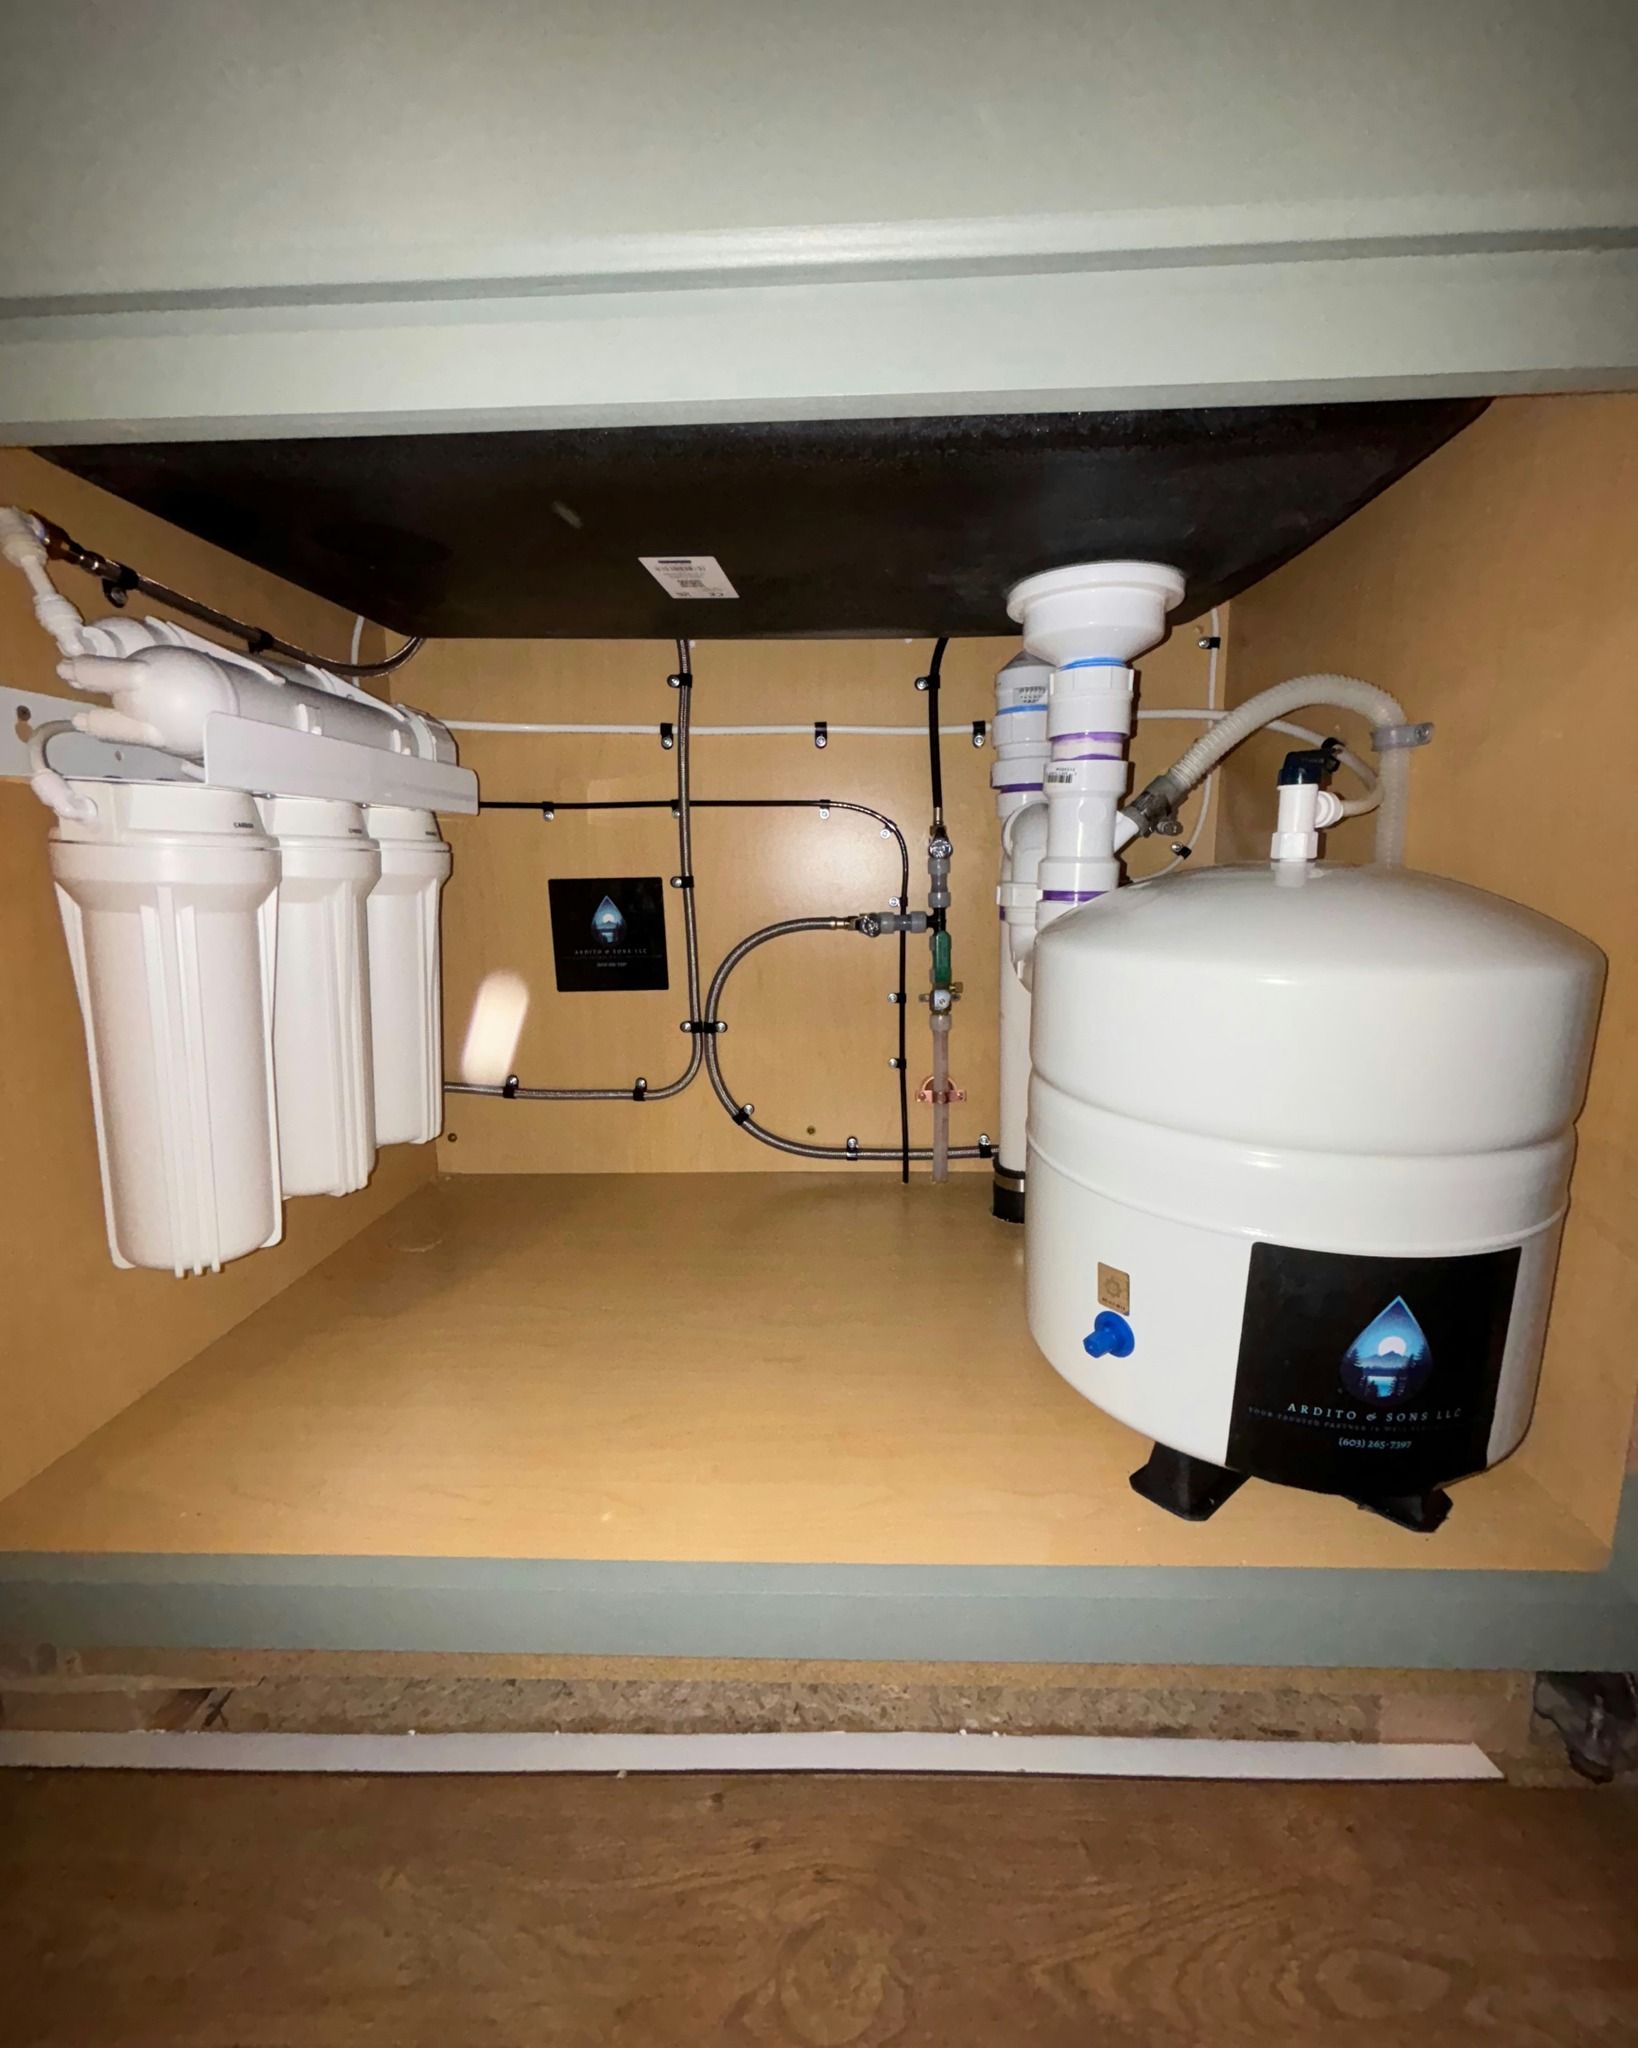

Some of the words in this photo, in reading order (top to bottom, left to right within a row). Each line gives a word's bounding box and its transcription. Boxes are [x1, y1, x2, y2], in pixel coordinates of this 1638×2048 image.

[1287, 1402, 1357, 1421] ARDITO
[1366, 1412, 1378, 1422] &
[1386, 1411, 1429, 1423] SONS
[1436, 1407, 1463, 1420] LLC
[1338, 1437, 1366, 1450] (603)
